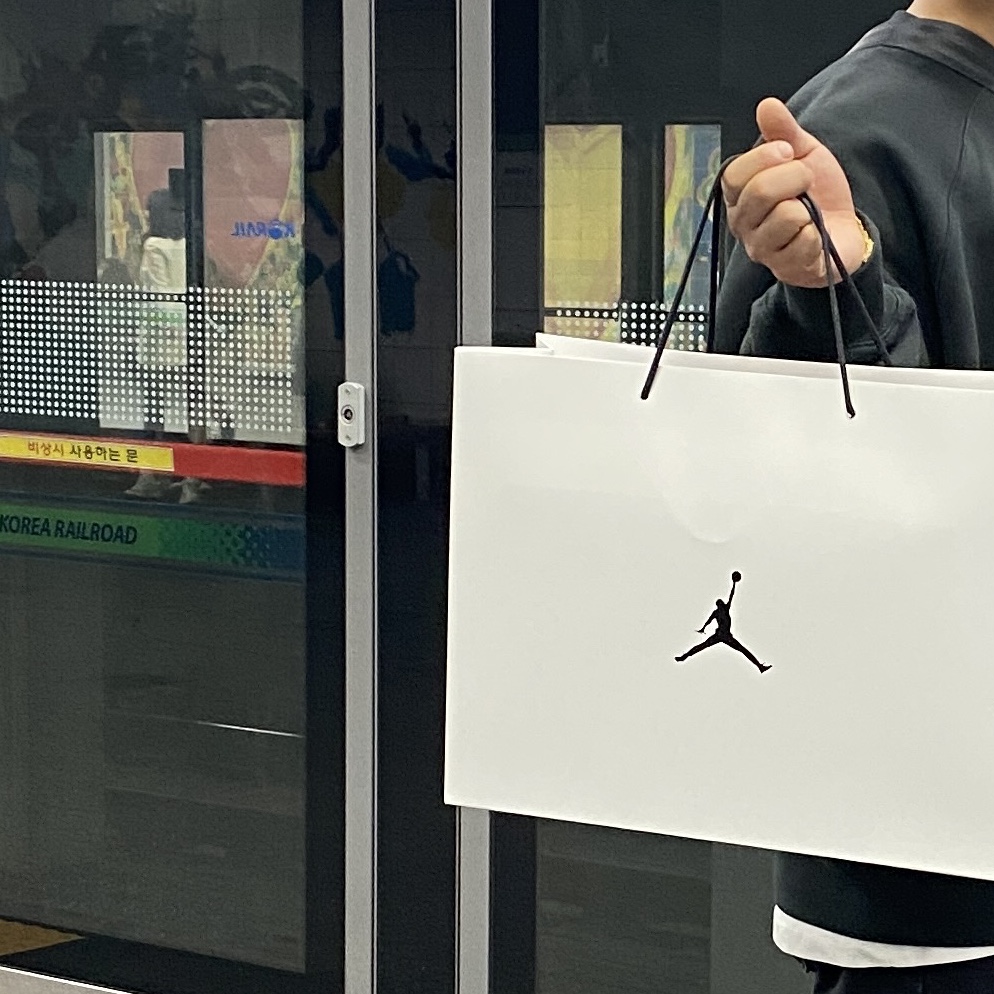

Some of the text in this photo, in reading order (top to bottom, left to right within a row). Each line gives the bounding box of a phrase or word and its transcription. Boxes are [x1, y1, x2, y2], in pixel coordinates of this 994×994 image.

[27, 441, 138, 463] 비상시 사용하는 문
[0, 514, 138, 545] KOREA RAILROAD
